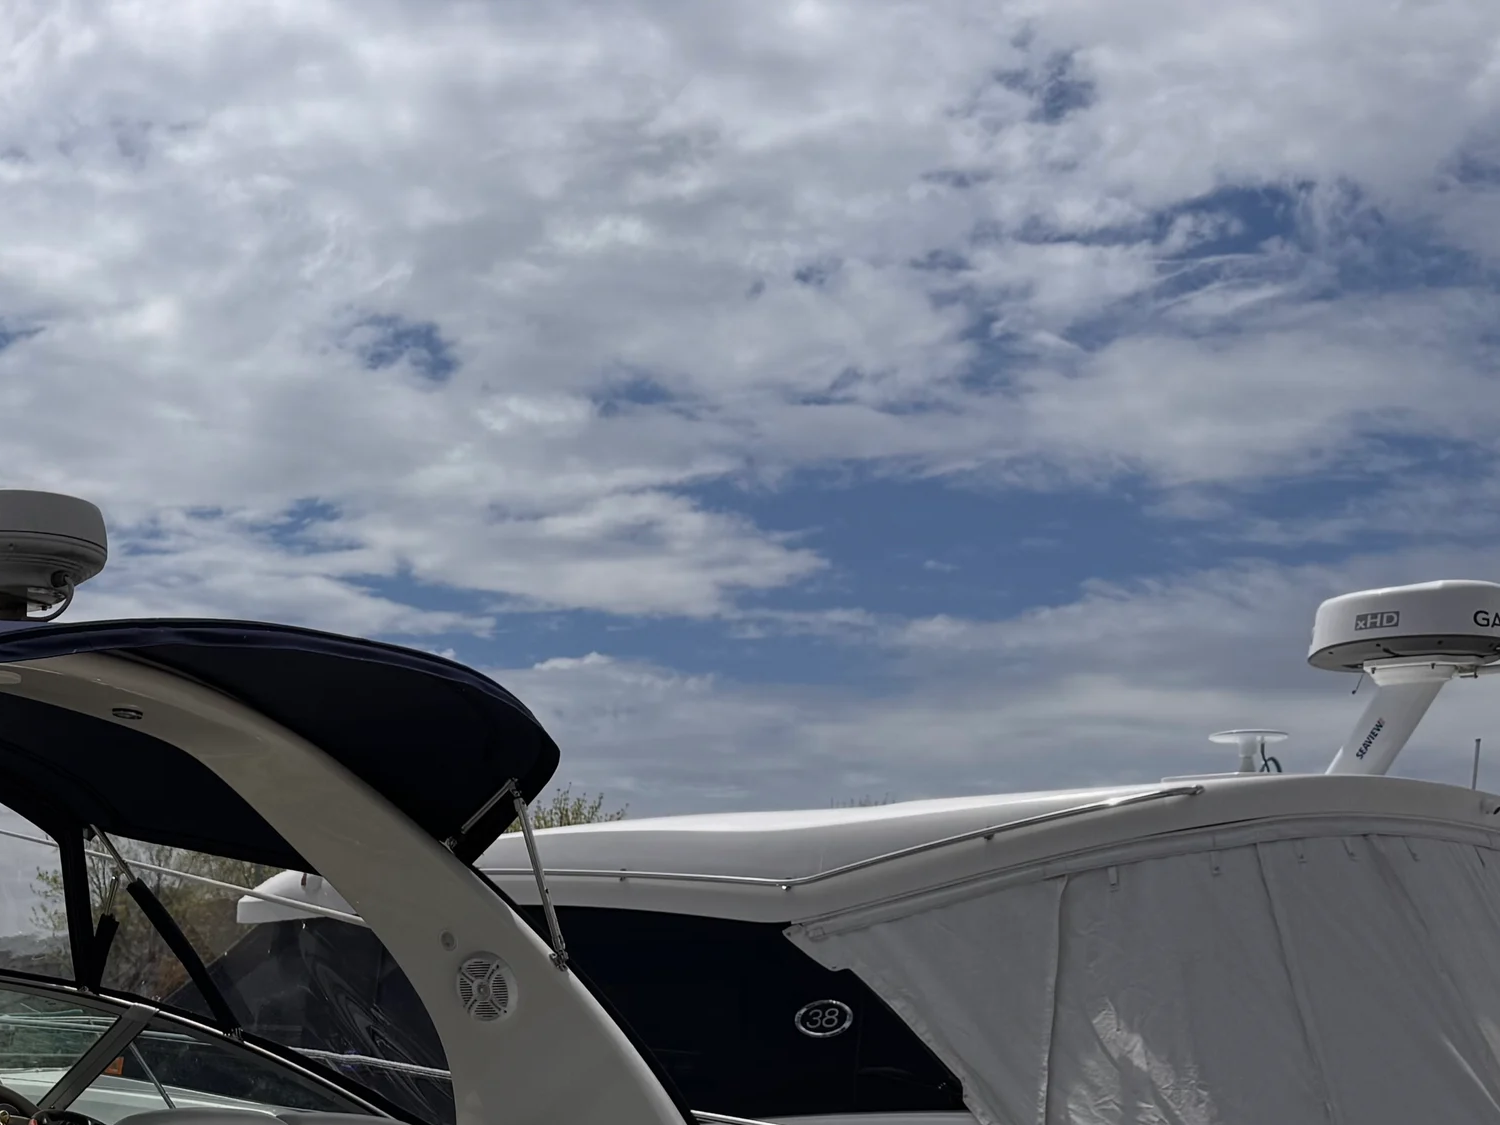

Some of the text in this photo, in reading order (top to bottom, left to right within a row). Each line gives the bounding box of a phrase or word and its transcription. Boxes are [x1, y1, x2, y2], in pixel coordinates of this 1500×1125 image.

[1356, 612, 1398, 629] xHD
[1356, 719, 1384, 760] SEAVIEW
[806, 1008, 839, 1028] 38
